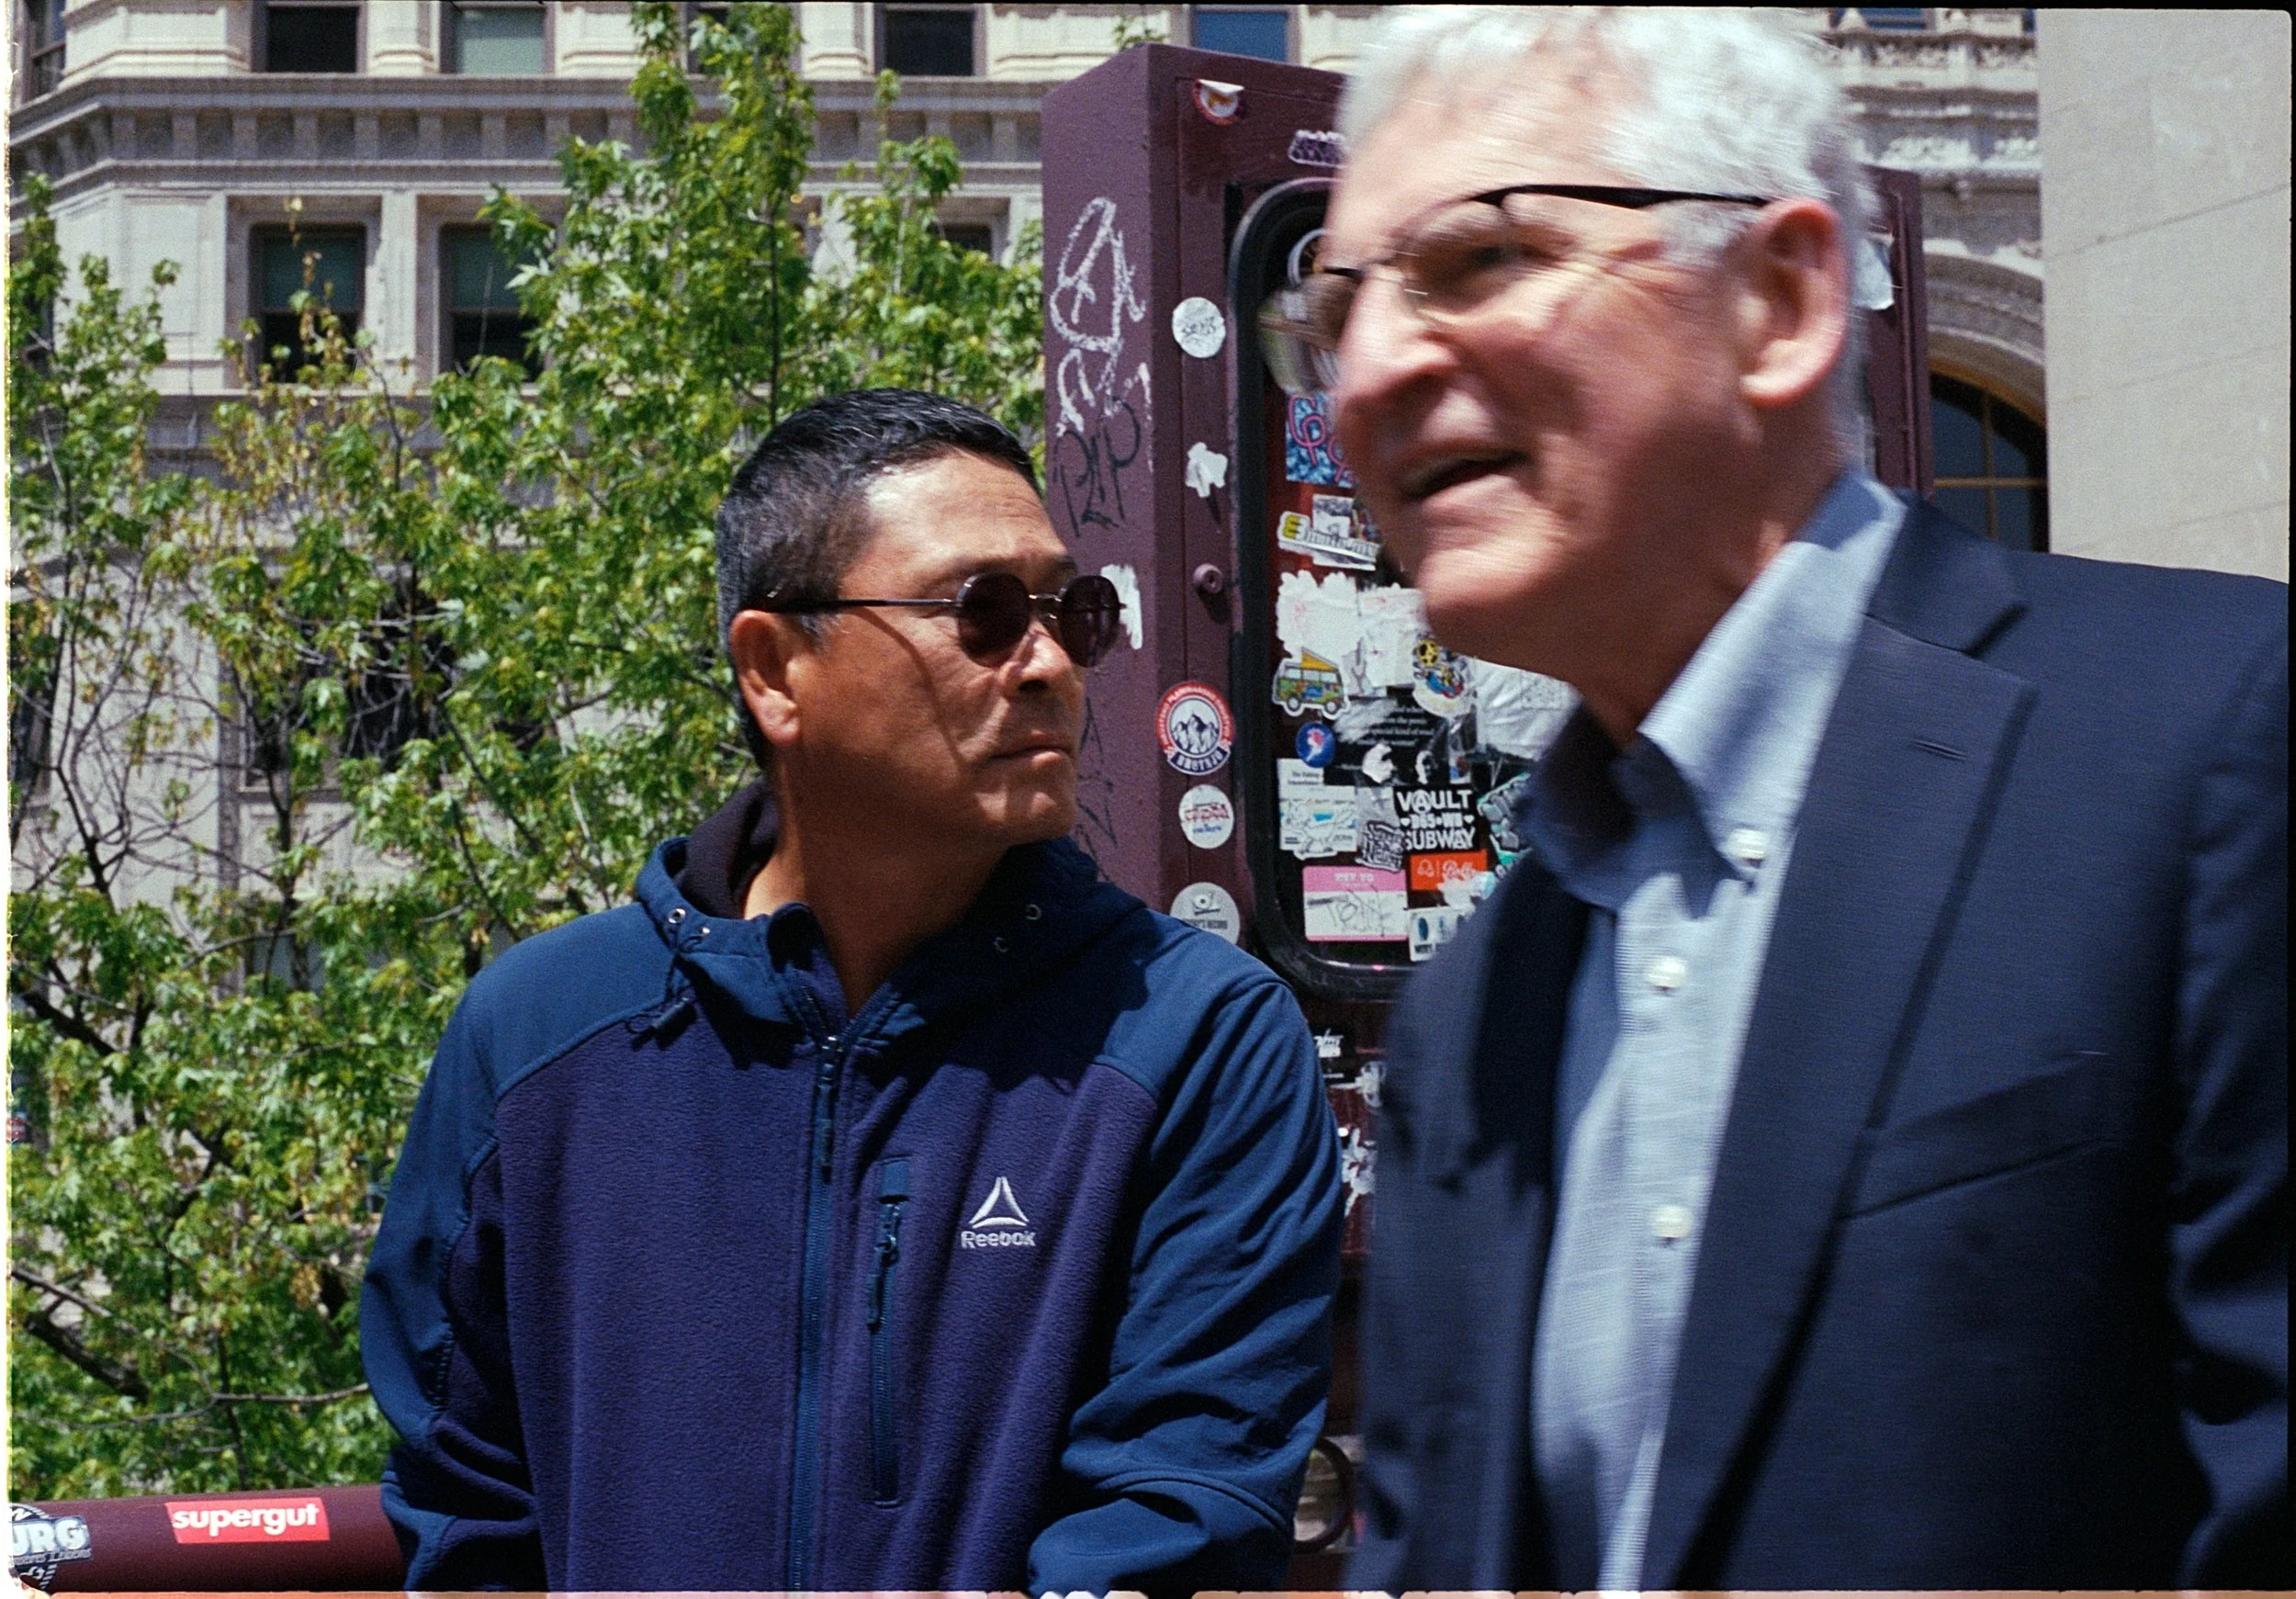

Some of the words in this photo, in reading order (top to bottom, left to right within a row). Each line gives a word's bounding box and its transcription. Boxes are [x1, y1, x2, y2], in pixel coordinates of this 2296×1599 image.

[1397, 789, 1473, 814] VAULT
[1404, 827, 1476, 850] SUBWAY
[961, 1231, 1036, 1249] Reebok
[172, 1503, 320, 1537] supergut
